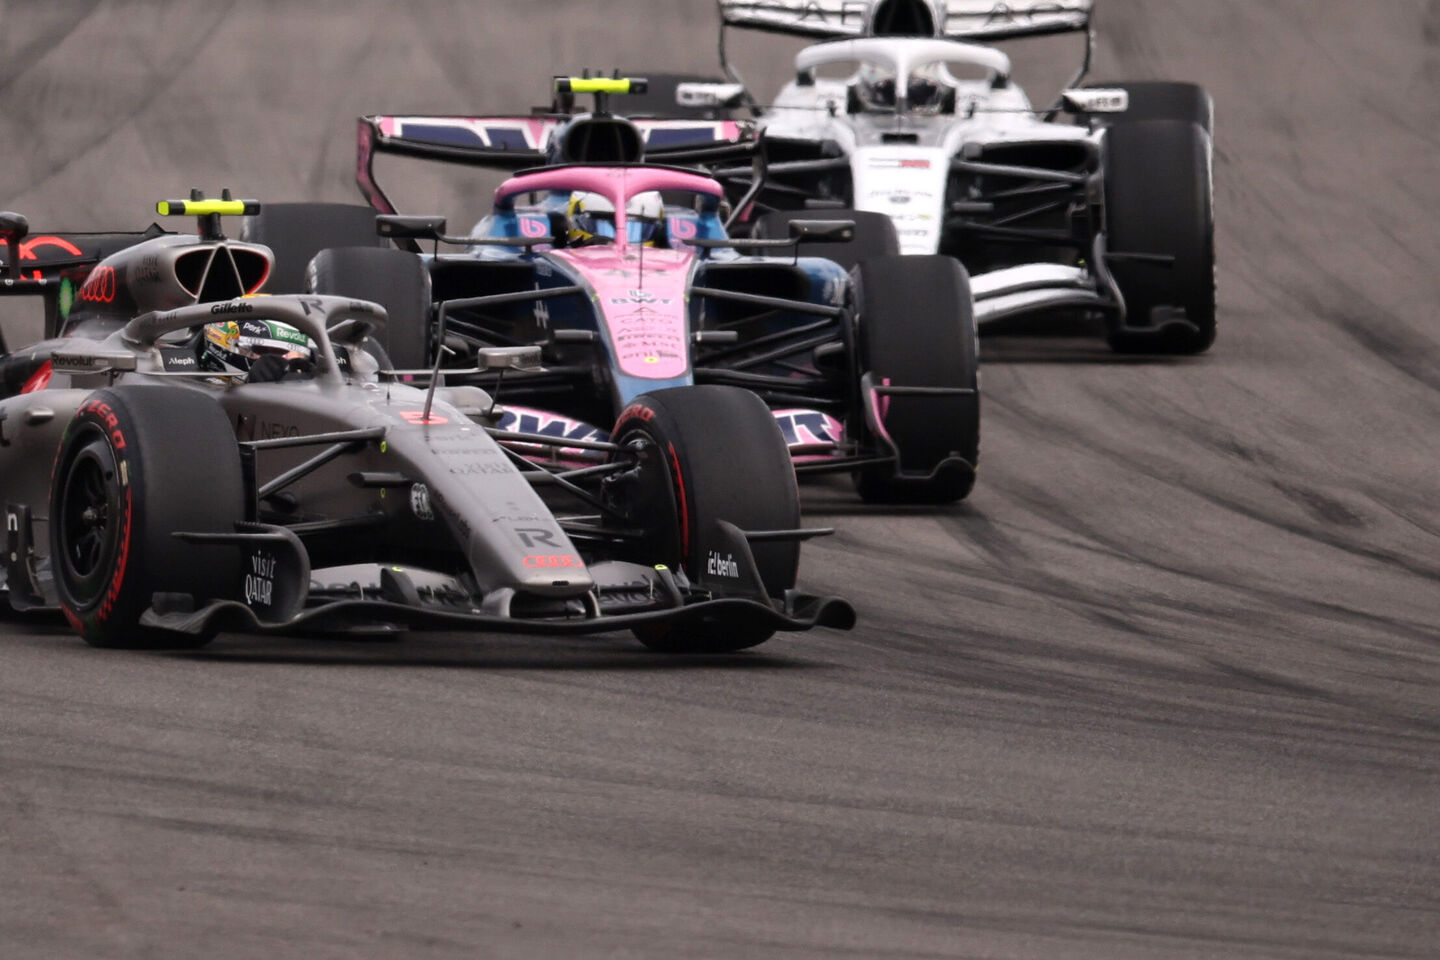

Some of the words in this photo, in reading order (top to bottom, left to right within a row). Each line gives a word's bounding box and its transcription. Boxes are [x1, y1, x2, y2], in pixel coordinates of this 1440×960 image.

[210, 301, 254, 315] Gillette
[51, 354, 95, 367] Revolut
[168, 356, 195, 366] Aleph
[87, 399, 127, 450] ZERO
[261, 422, 300, 440] NEXO
[251, 550, 277, 579] visit
[245, 574, 273, 606] QATAR
